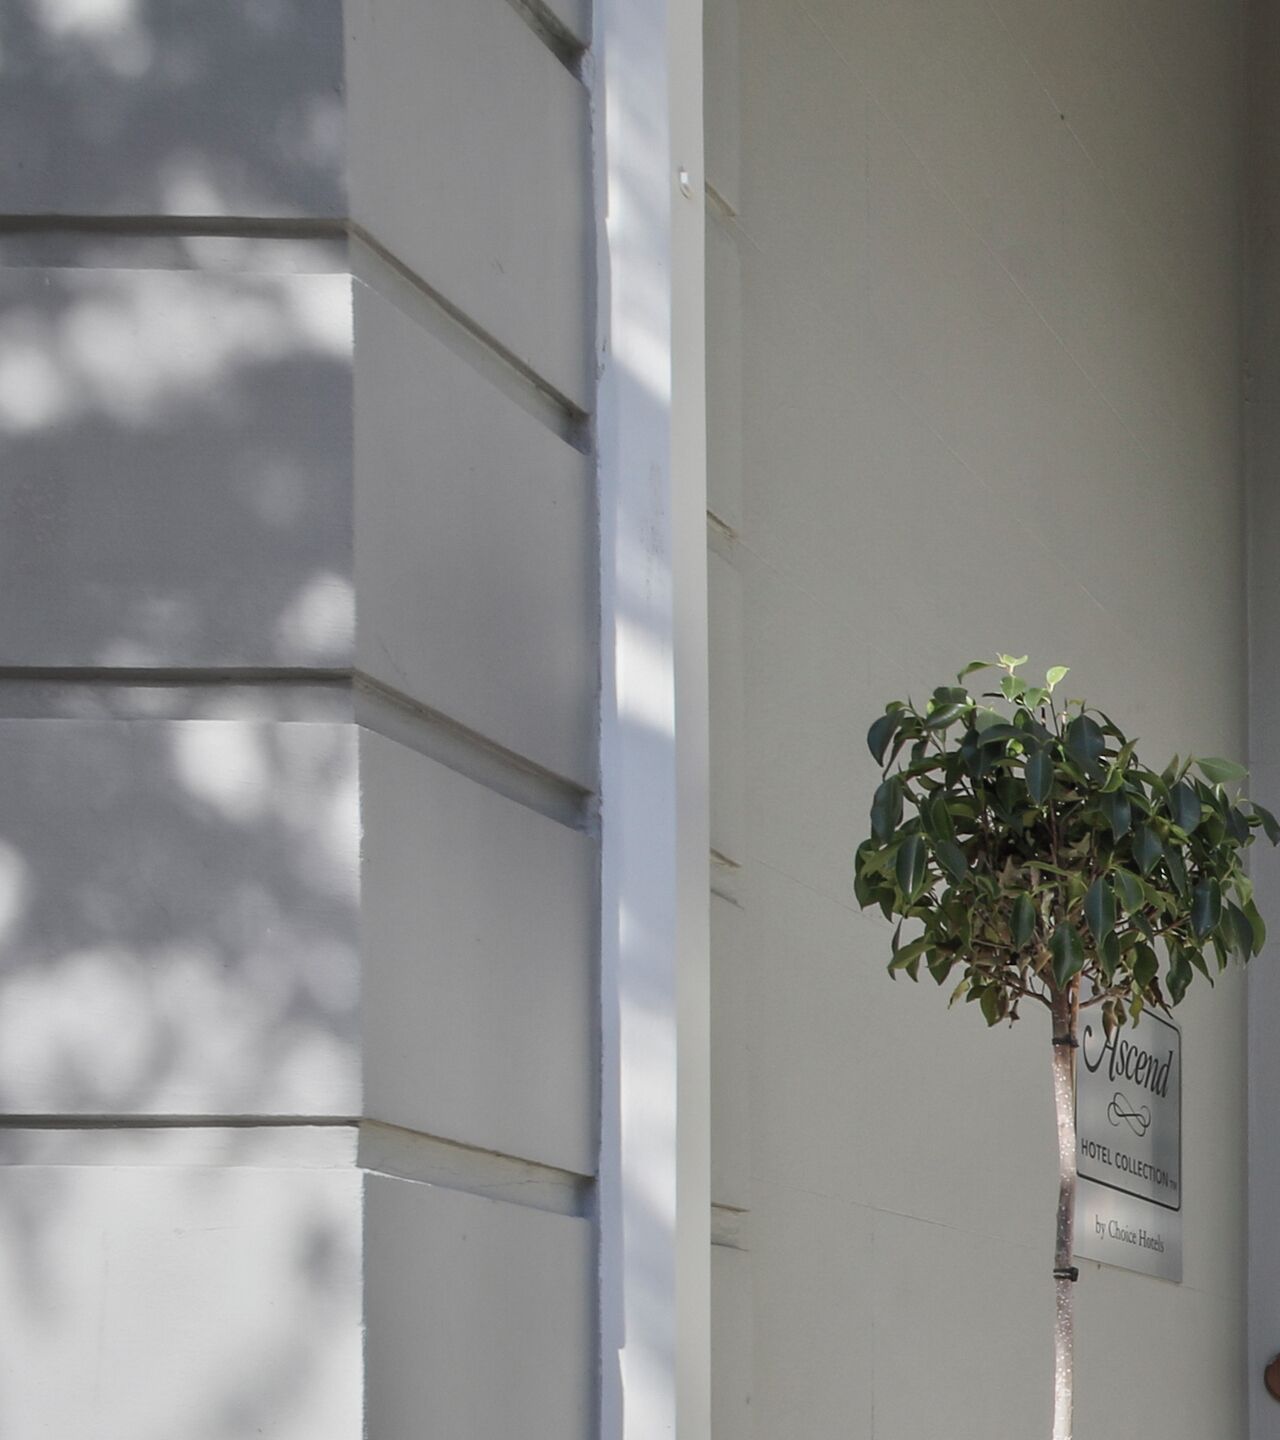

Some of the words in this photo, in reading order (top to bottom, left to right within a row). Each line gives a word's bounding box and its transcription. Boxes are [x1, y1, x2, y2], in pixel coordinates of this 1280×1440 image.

[1083, 1024, 1174, 1098] Ascend
[1081, 1138, 1112, 1166] HOTEL
[1114, 1152, 1168, 1187] COLLECTION
[1095, 1214, 1107, 1240] by
[1108, 1220, 1137, 1245] Choice
[1139, 1229, 1165, 1253] Hotels
